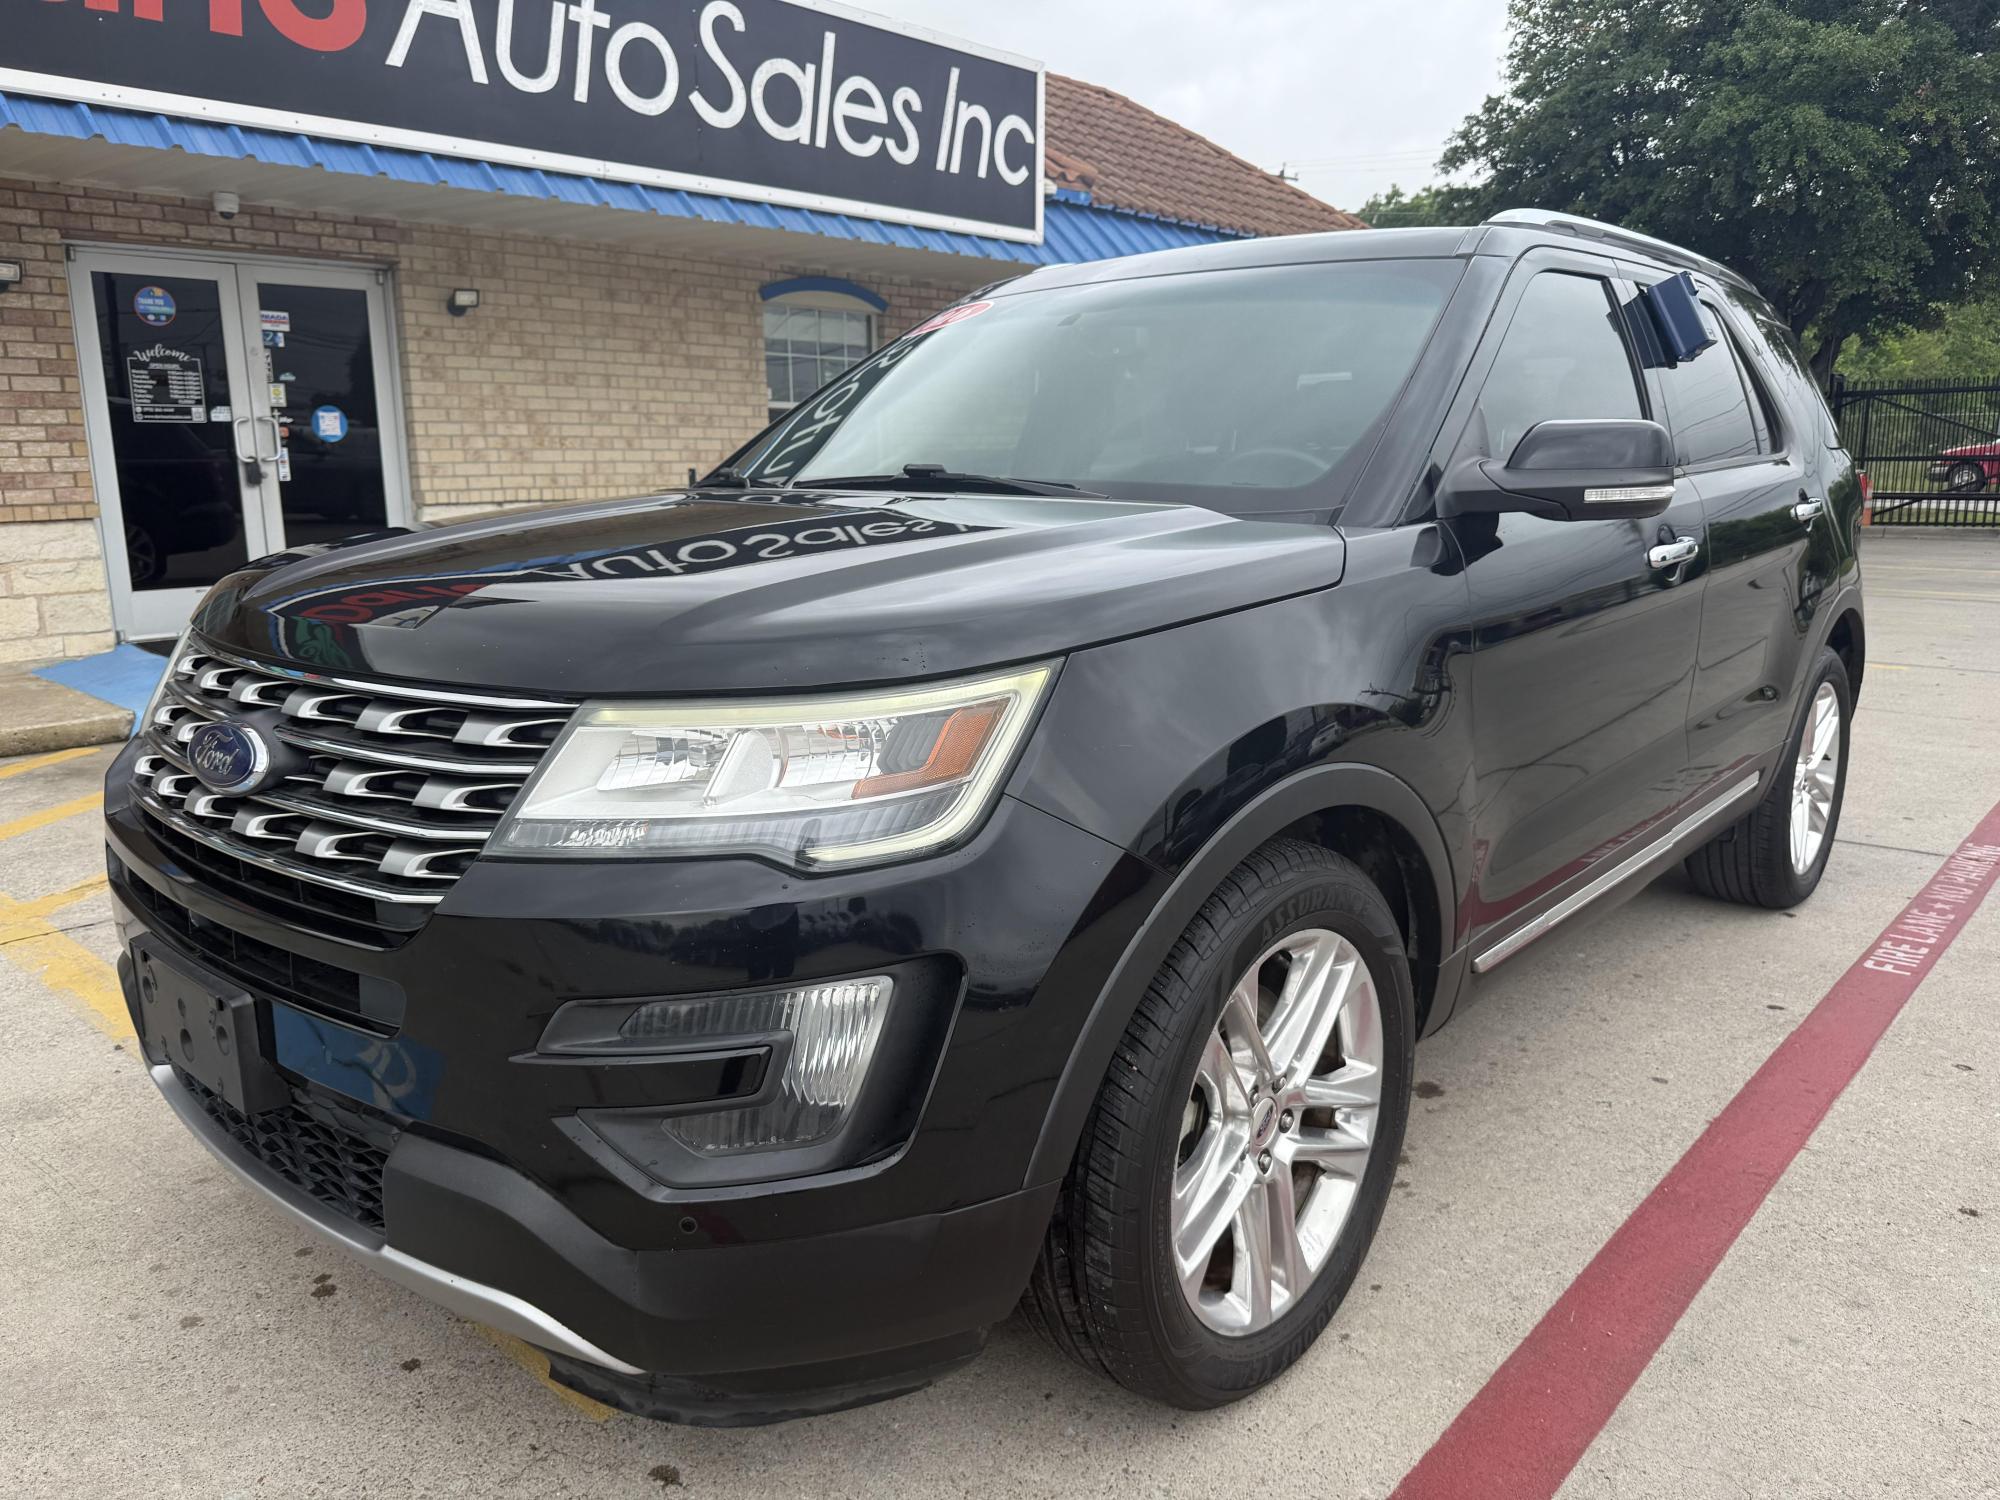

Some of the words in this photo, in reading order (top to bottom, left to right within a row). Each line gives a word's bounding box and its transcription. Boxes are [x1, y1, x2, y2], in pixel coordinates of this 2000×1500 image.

[385, 0, 679, 116] Auto
[688, 0, 922, 165] Sales
[936, 67, 1035, 186] Inc
[133, 344, 190, 362] Welcome
[195, 730, 240, 775] Ford
[1923, 884, 1974, 904] NO
[1887, 908, 1956, 944] LANE
[1863, 941, 1930, 976] FIRE
